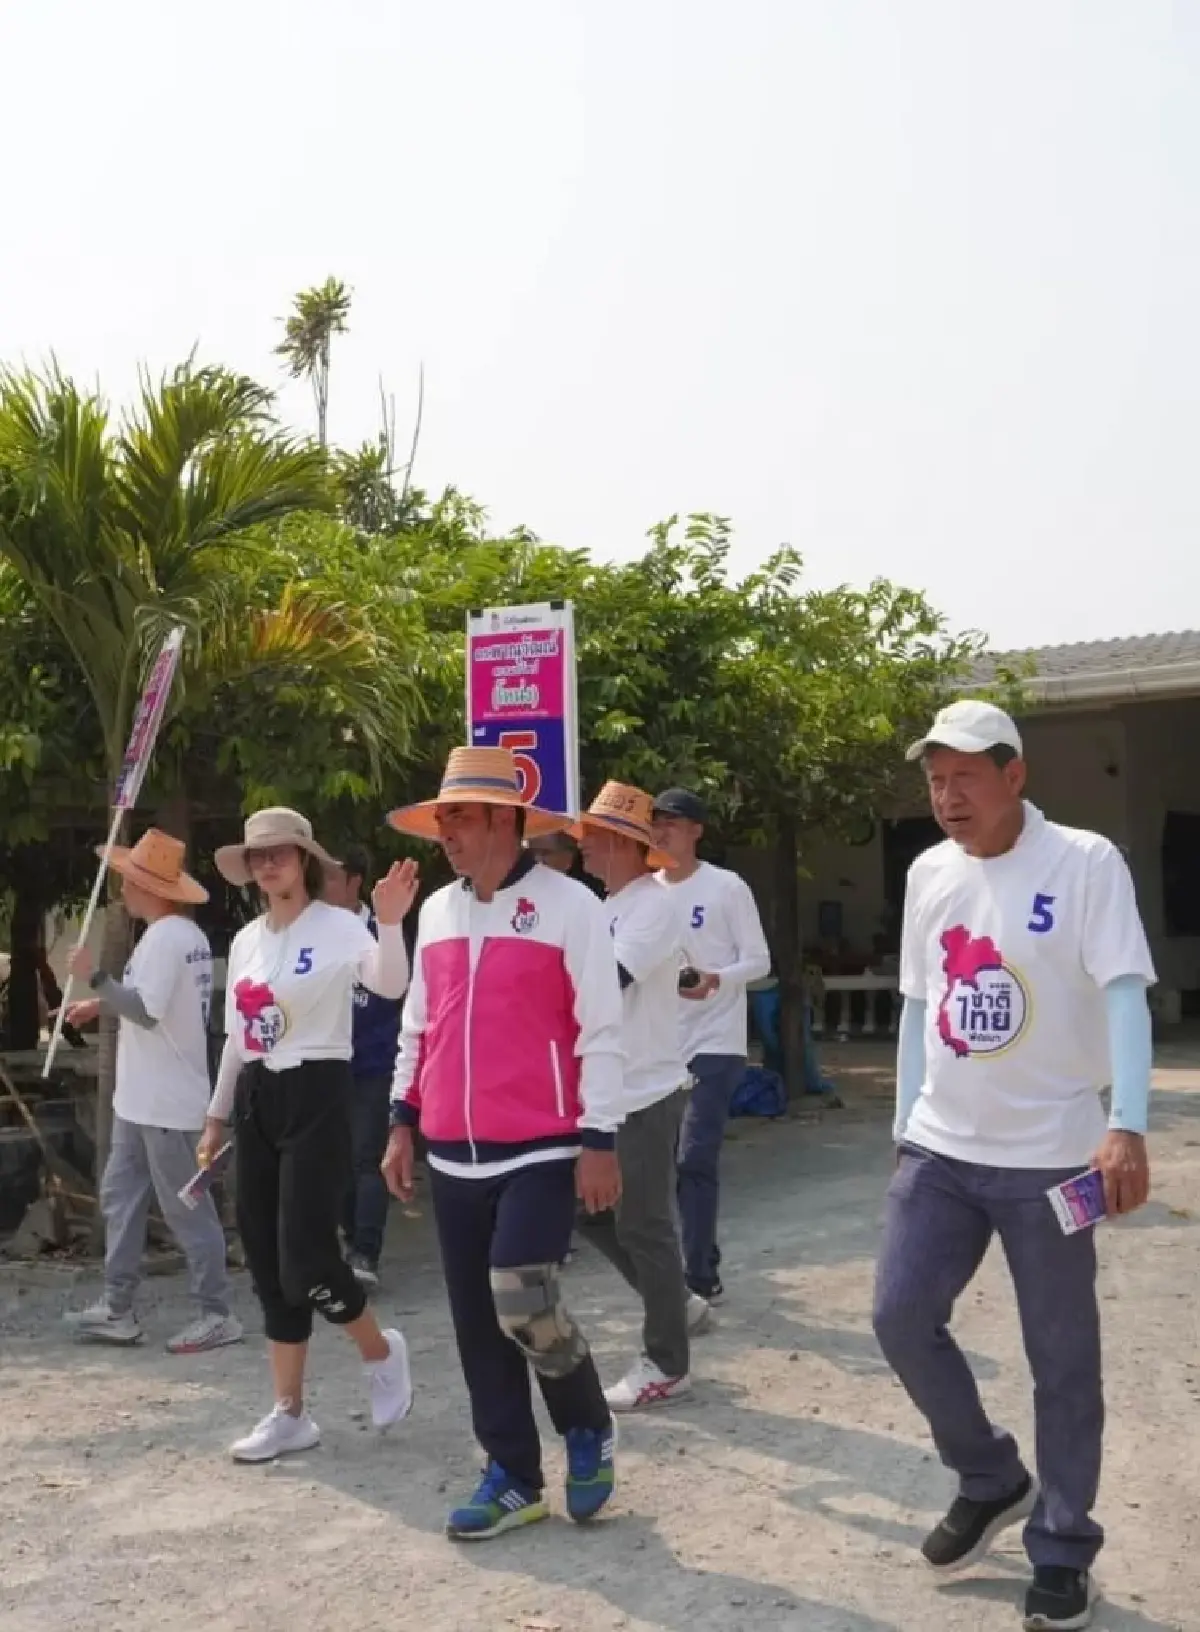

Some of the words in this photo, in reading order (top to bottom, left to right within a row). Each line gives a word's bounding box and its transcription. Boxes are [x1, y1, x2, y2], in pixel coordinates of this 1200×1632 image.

[499, 730, 542, 804] 5
[691, 905, 705, 929] 5
[1027, 892, 1057, 933] 5
[294, 947, 314, 975] 5
[956, 995, 1011, 1031] ไทย
[971, 991, 1011, 1009] ชาติ
